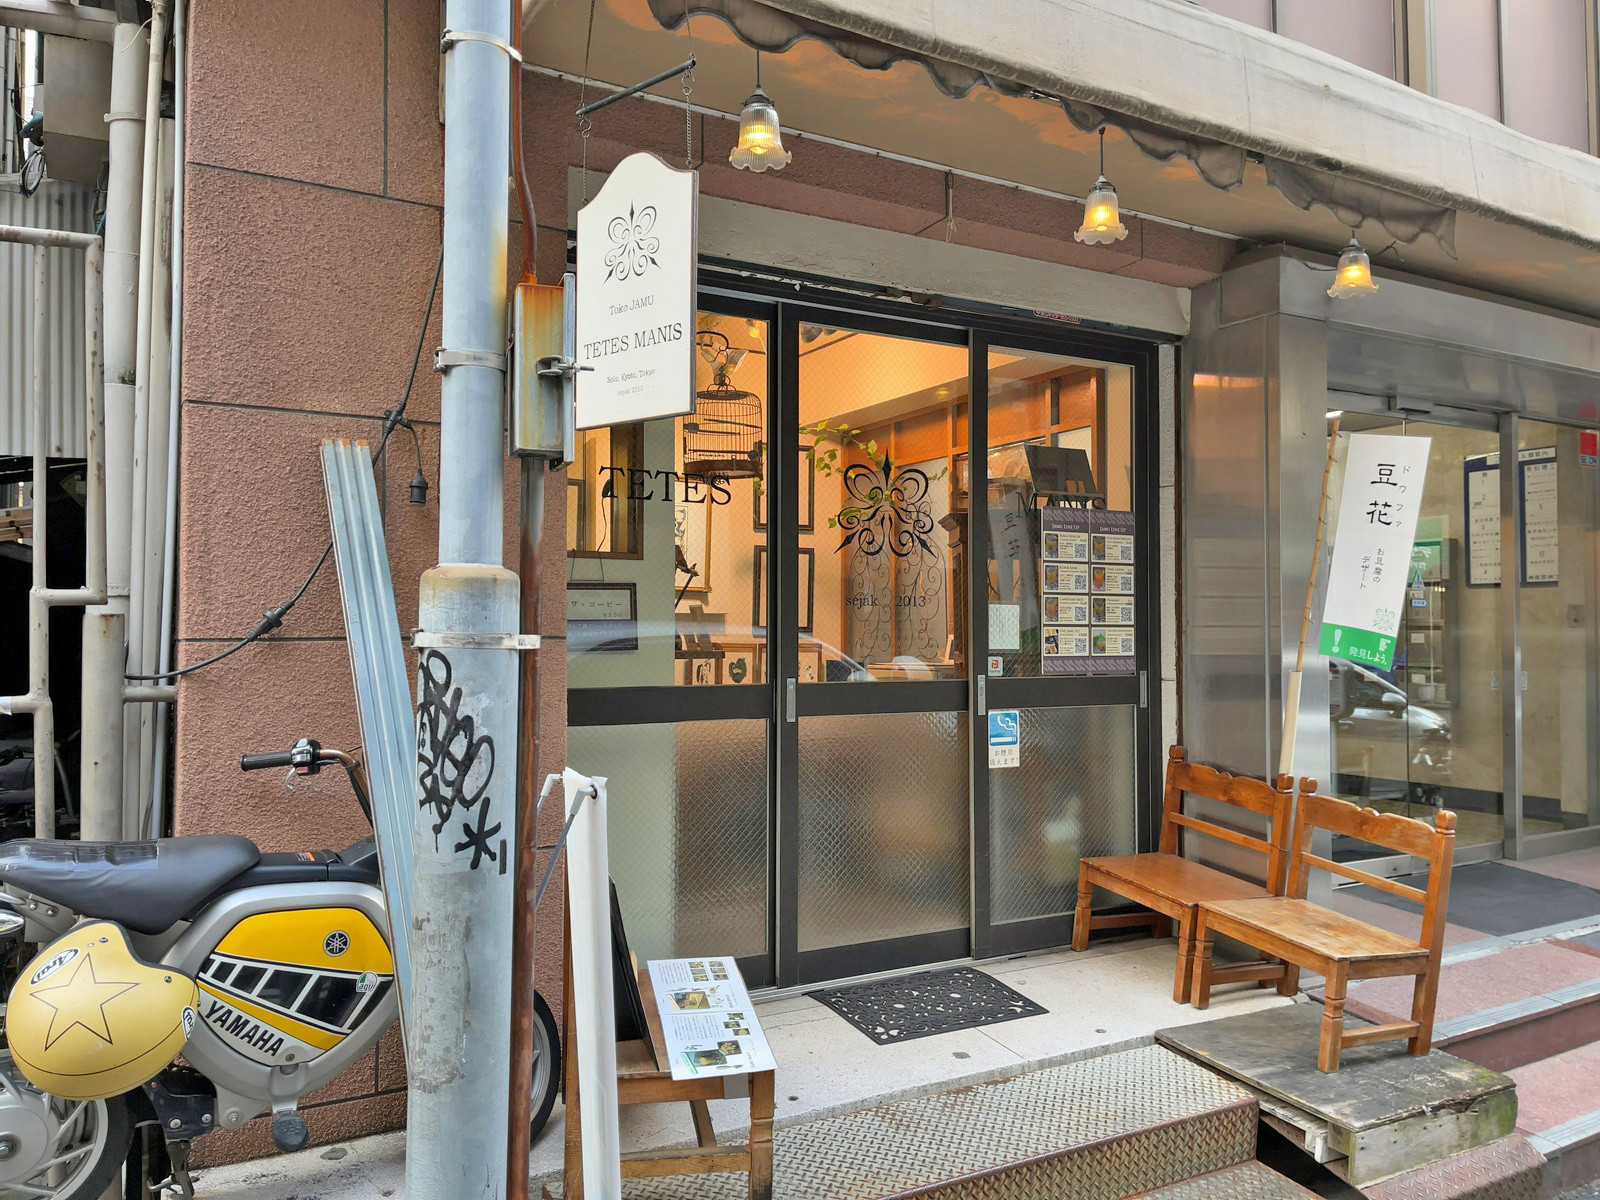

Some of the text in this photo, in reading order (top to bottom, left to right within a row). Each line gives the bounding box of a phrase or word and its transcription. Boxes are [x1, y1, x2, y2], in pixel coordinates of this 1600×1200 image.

[609, 295, 655, 316] Toko JAMU
[584, 322, 682, 360] TETES MANIS
[639, 368, 656, 378] Tokyo
[598, 465, 732, 506] TETES
[1366, 463, 1398, 526] 豆花
[846, 594, 926, 609] sejak 2013
[33, 951, 72, 982] Arai
[205, 1000, 285, 1057] YAMAHA
